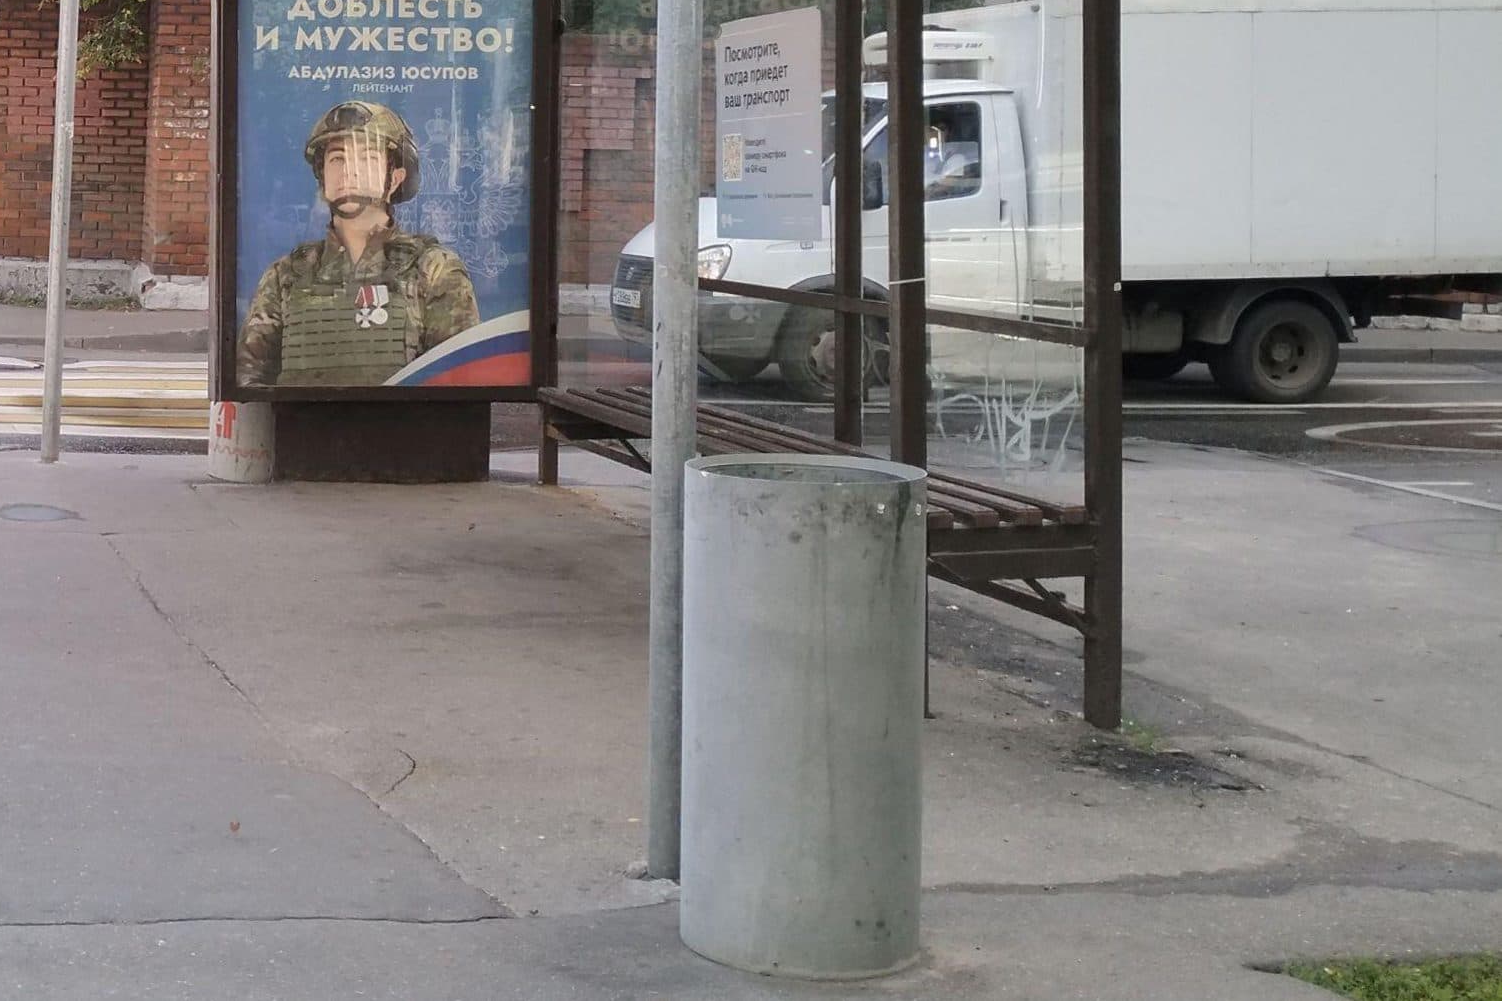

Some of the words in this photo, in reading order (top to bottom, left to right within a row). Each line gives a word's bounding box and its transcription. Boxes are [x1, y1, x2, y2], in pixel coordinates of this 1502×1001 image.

[255, 26, 280, 51] И
[295, 26, 514, 53] МУЖЕСТВО!
[724, 41, 781, 64] Посмотрите,
[287, 65, 396, 81] АБДУЛАЗИЗ
[401, 65, 479, 81] ЮСУПОВ
[724, 68, 749, 88] когда
[750, 63, 788, 85] приедет
[352, 81, 415, 94] ЛЕЙТЕНАНТ
[724, 94, 742, 109] ваш
[743, 87, 791, 111] транспорт
